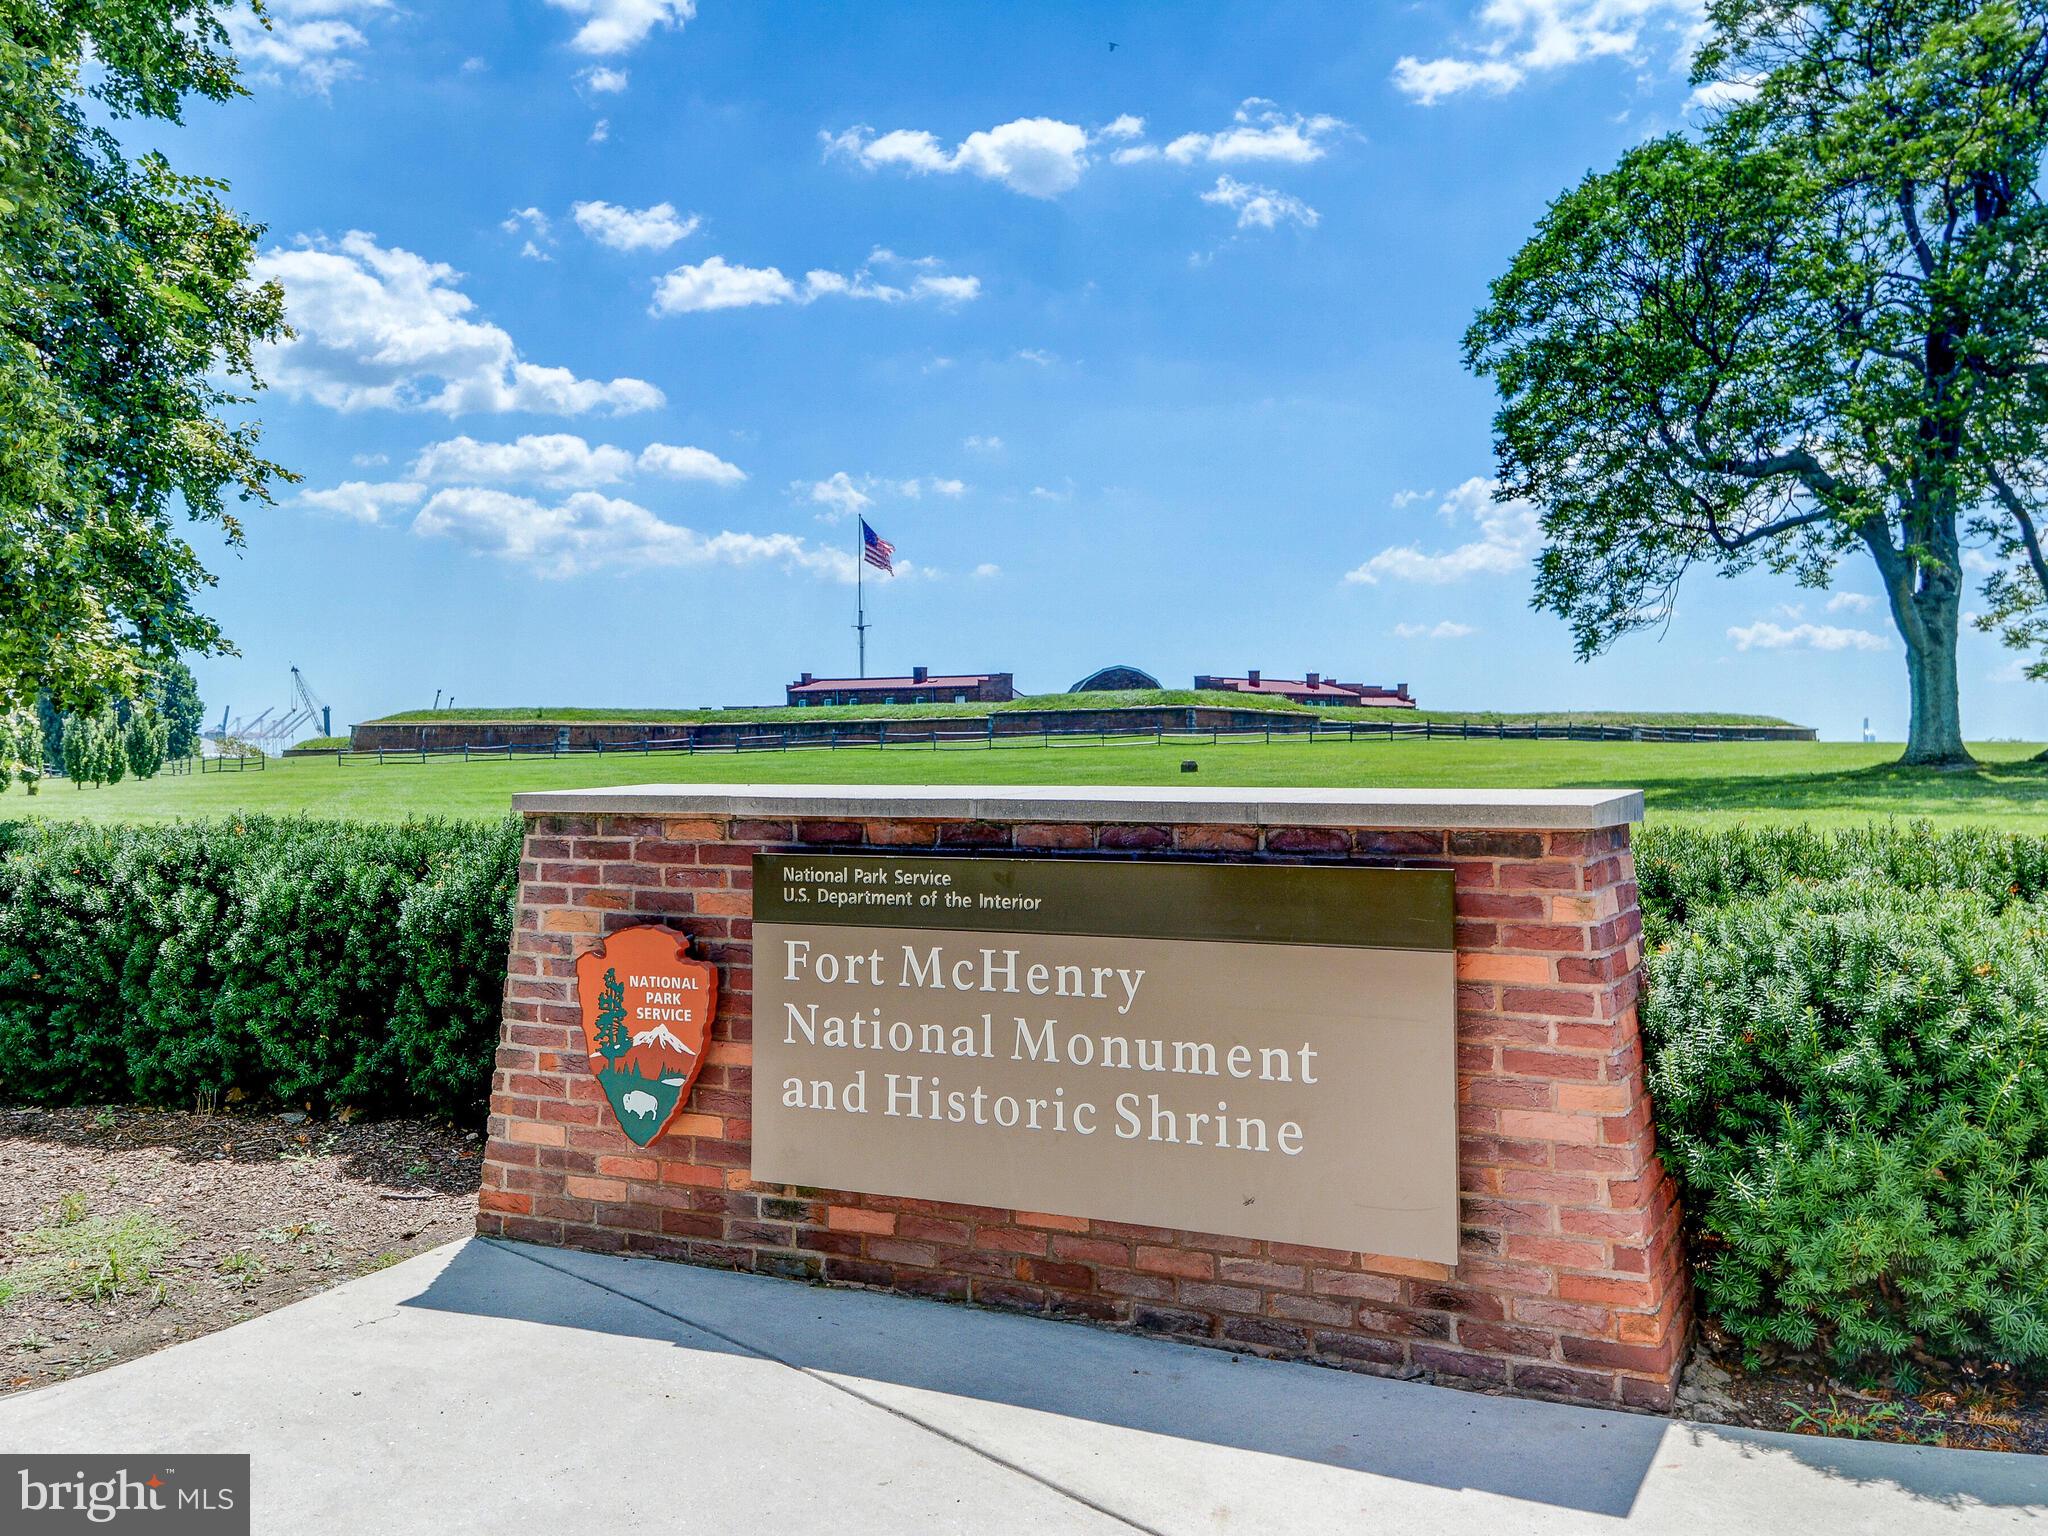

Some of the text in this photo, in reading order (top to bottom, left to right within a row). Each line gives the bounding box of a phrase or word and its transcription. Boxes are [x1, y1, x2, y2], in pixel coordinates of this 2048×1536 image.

[783, 866, 952, 888] National Park Service
[783, 887, 1042, 911] U.S. Department of the Interior
[629, 975, 699, 990] NATIONAL
[783, 940, 1146, 1014] Fort McHenry
[646, 991, 681, 1005] PARK
[636, 1007, 692, 1022] SERVICE
[783, 1003, 1319, 1084] National Monument
[782, 1070, 1304, 1156] and Historic Shrine
